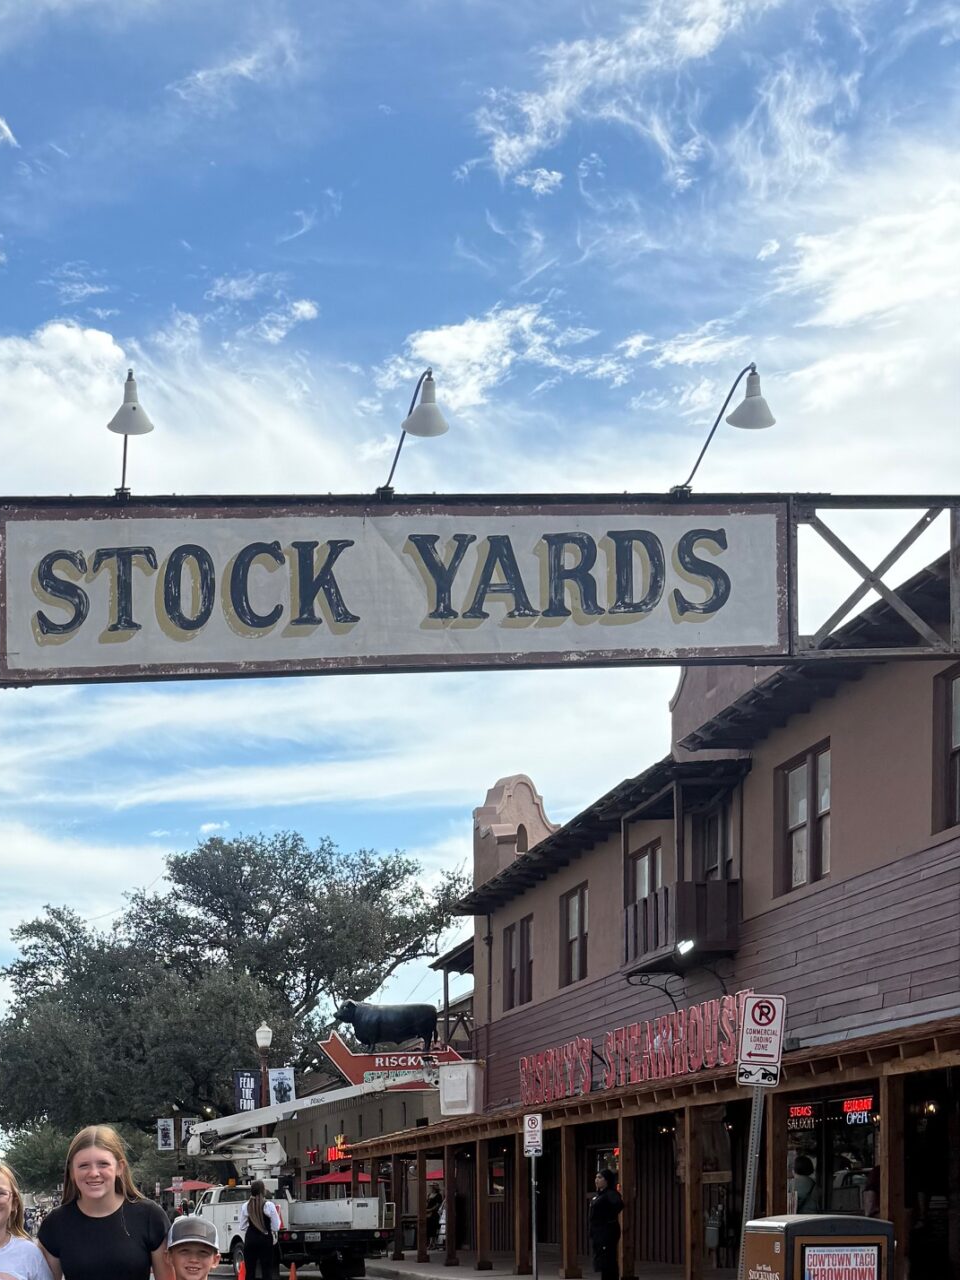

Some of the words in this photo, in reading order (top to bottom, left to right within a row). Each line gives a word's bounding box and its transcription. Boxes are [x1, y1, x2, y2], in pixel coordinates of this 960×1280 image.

[31, 540, 360, 646] STOCK
[403, 528, 731, 630] YARDS
[746, 1027, 778, 1036] COMMERCIAL
[754, 1043, 768, 1051] ZONE
[240, 1077, 254, 1088] FEAR
[242, 1088, 252, 1099] THE
[790, 1106, 812, 1117] STEAKS
[787, 1117, 814, 1129] SALOON
[846, 1111, 868, 1124] OPEN
[807, 1253, 851, 1267] COWTOWN
[853, 1253, 876, 1267] TACO
